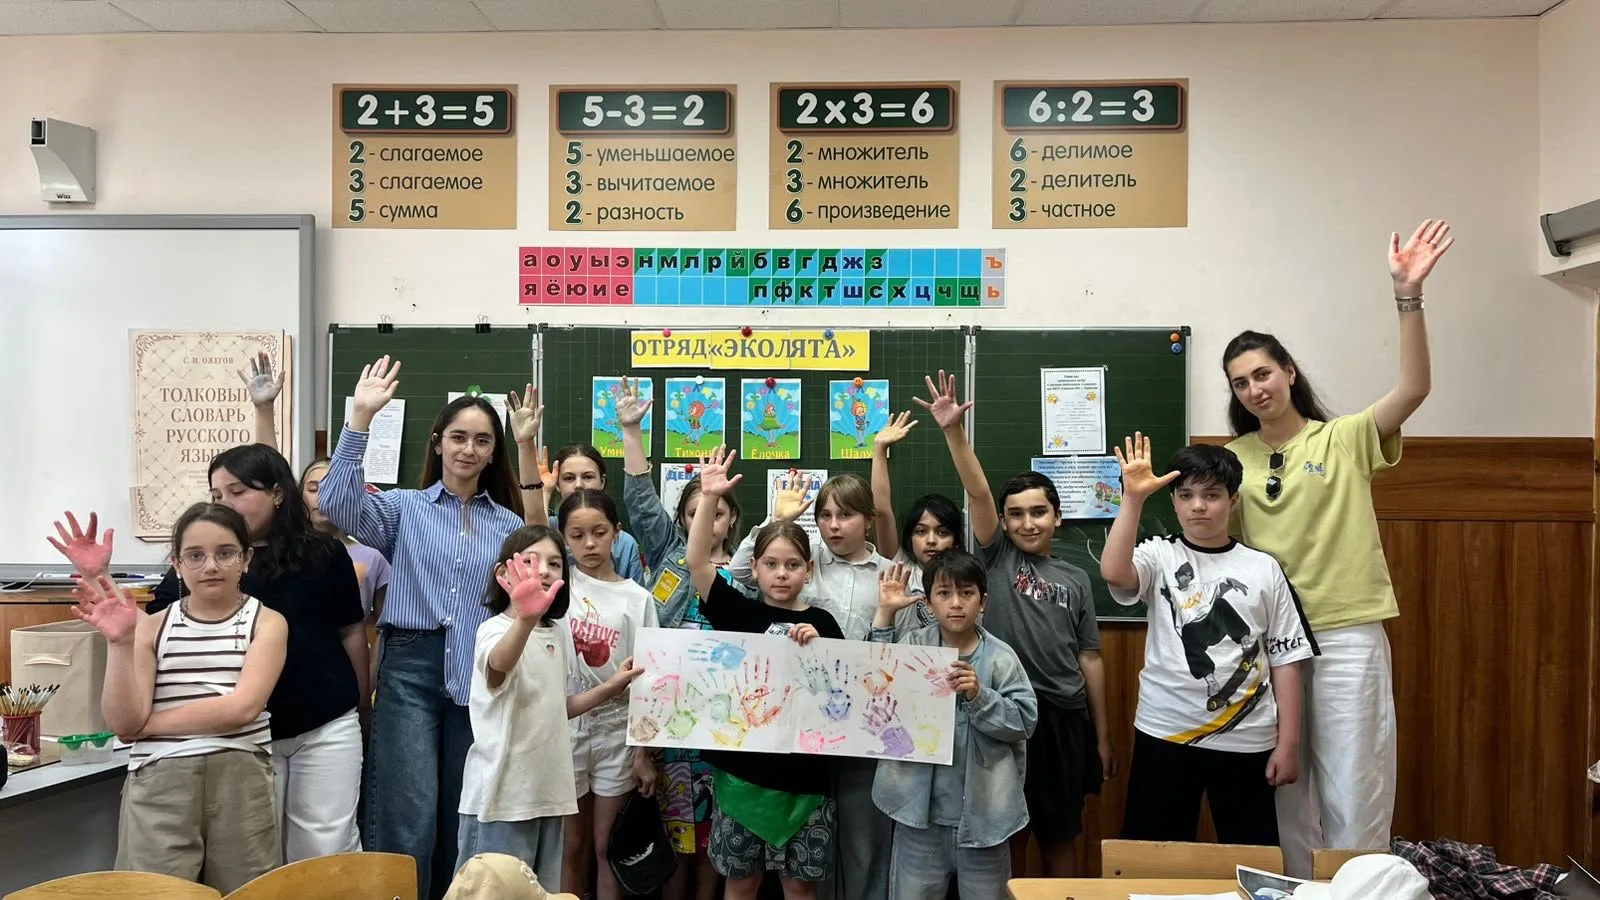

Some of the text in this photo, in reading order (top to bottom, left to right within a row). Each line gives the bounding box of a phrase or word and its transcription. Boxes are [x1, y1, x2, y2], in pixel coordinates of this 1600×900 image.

[380, 147, 483, 162] слагаемое
[597, 147, 735, 166] уменьшаемое
[818, 146, 929, 161] множитель
[1042, 144, 1132, 162] делимое
[380, 175, 483, 190] слагаемое
[597, 177, 715, 192] вычитаемое
[818, 175, 929, 190] множитель
[1042, 173, 1137, 191] делитель
[380, 204, 438, 222] сумма
[597, 206, 684, 224] разность
[818, 204, 951, 223] произведение
[1042, 203, 1116, 218] частное
[171, 407, 246, 423] СЛОВАРЬ
[166, 429, 250, 443] РУССКОГО
[841, 448, 872, 459] Шалу
[571, 617, 620, 648] OSITIVE
